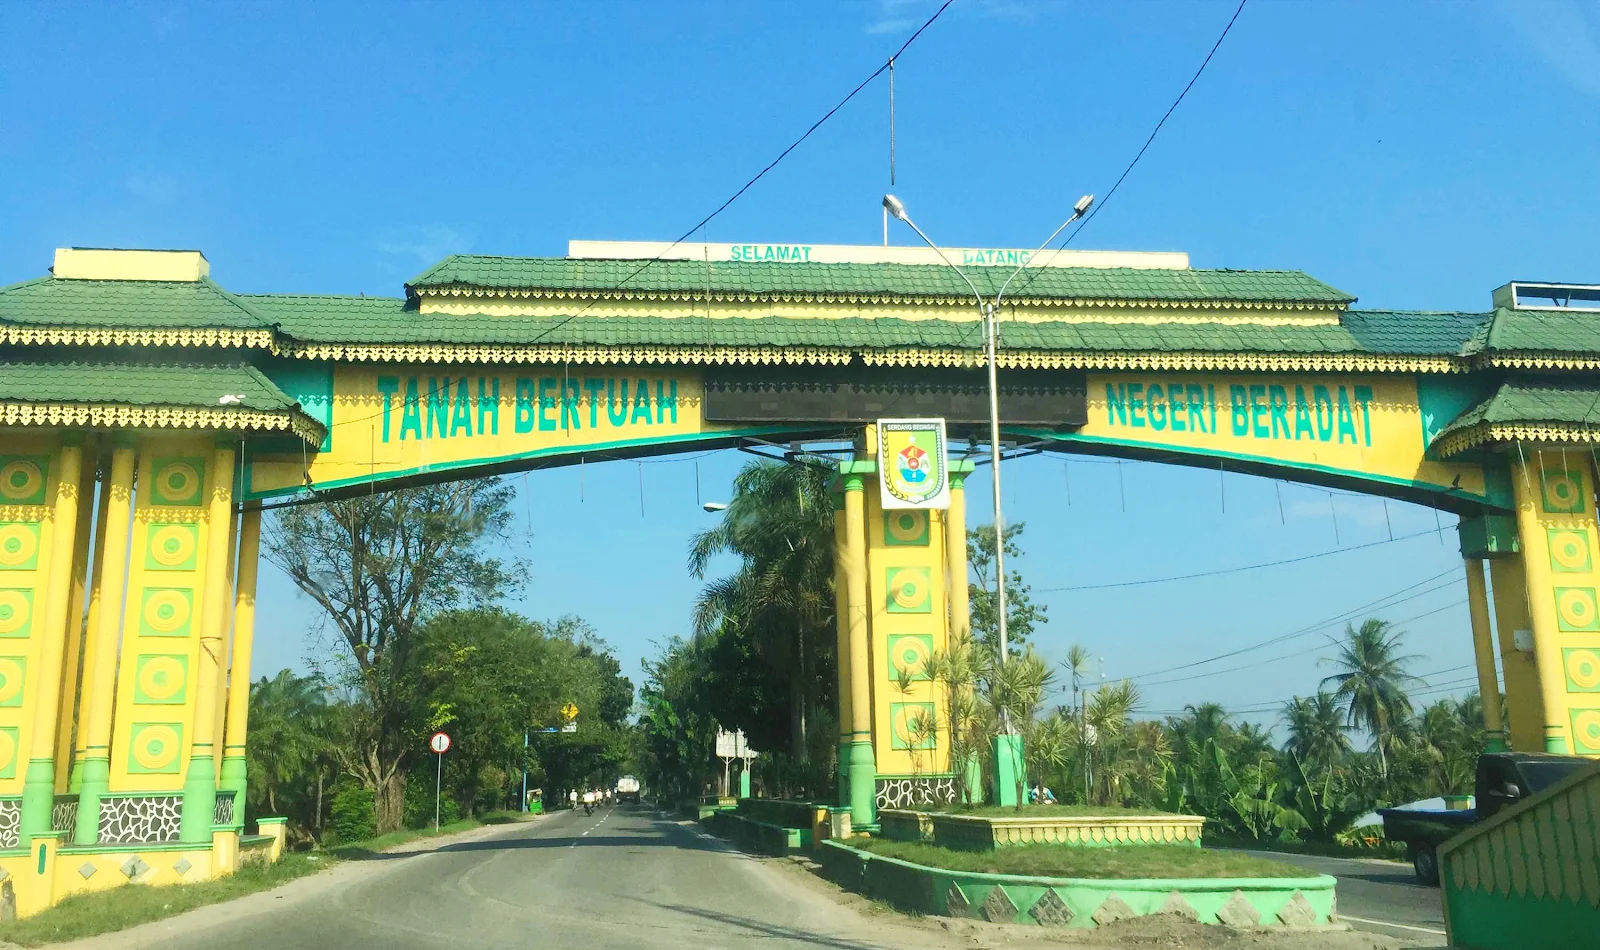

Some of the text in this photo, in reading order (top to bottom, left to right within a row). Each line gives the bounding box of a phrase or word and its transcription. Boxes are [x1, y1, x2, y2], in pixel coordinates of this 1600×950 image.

[731, 245, 1031, 265] SELAMAT DATANG
[377, 376, 678, 443] TANAH BERTUAH
[1105, 383, 1373, 447] NEGERI BERADAT
